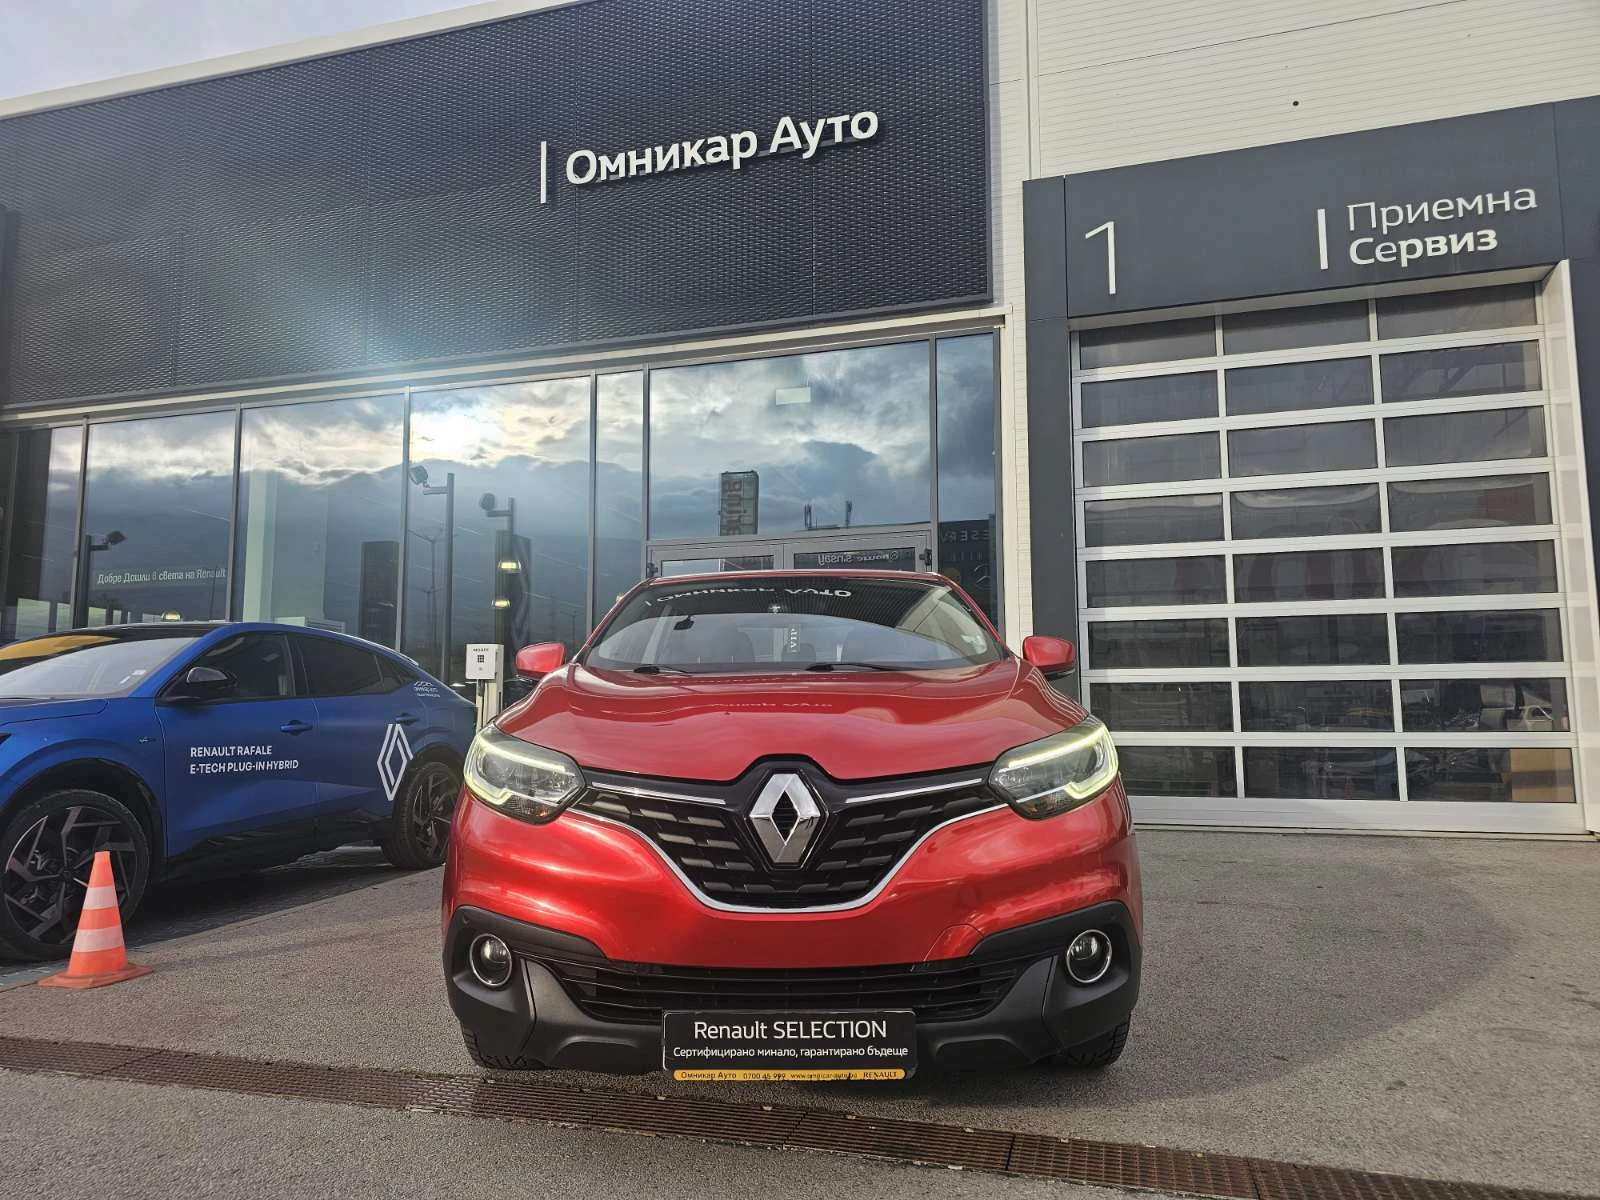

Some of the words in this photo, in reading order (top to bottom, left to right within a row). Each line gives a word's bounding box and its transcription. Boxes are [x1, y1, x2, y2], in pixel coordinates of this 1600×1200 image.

[566, 130, 758, 185] Омникар
[769, 111, 879, 159] Ауто
[1346, 188, 1538, 235] Приемна
[1350, 228, 1498, 268] Сервиз
[1085, 221, 1116, 295] 1
[190, 746, 236, 757] RENAULT
[237, 745, 273, 756] RAFALE
[190, 762, 226, 774] E-TECH
[227, 761, 265, 772] PLUG-IN
[266, 759, 299, 771] HYBRID
[694, 1020, 768, 1039] Renault
[773, 1020, 887, 1039] SELECTION
[673, 1046, 756, 1060] Сертифицирано
[757, 1048, 798, 1059] минало,
[800, 1047, 865, 1059] гарантирано
[867, 1045, 909, 1058] бъдеще
[863, 1070, 898, 1079] RENAULT
